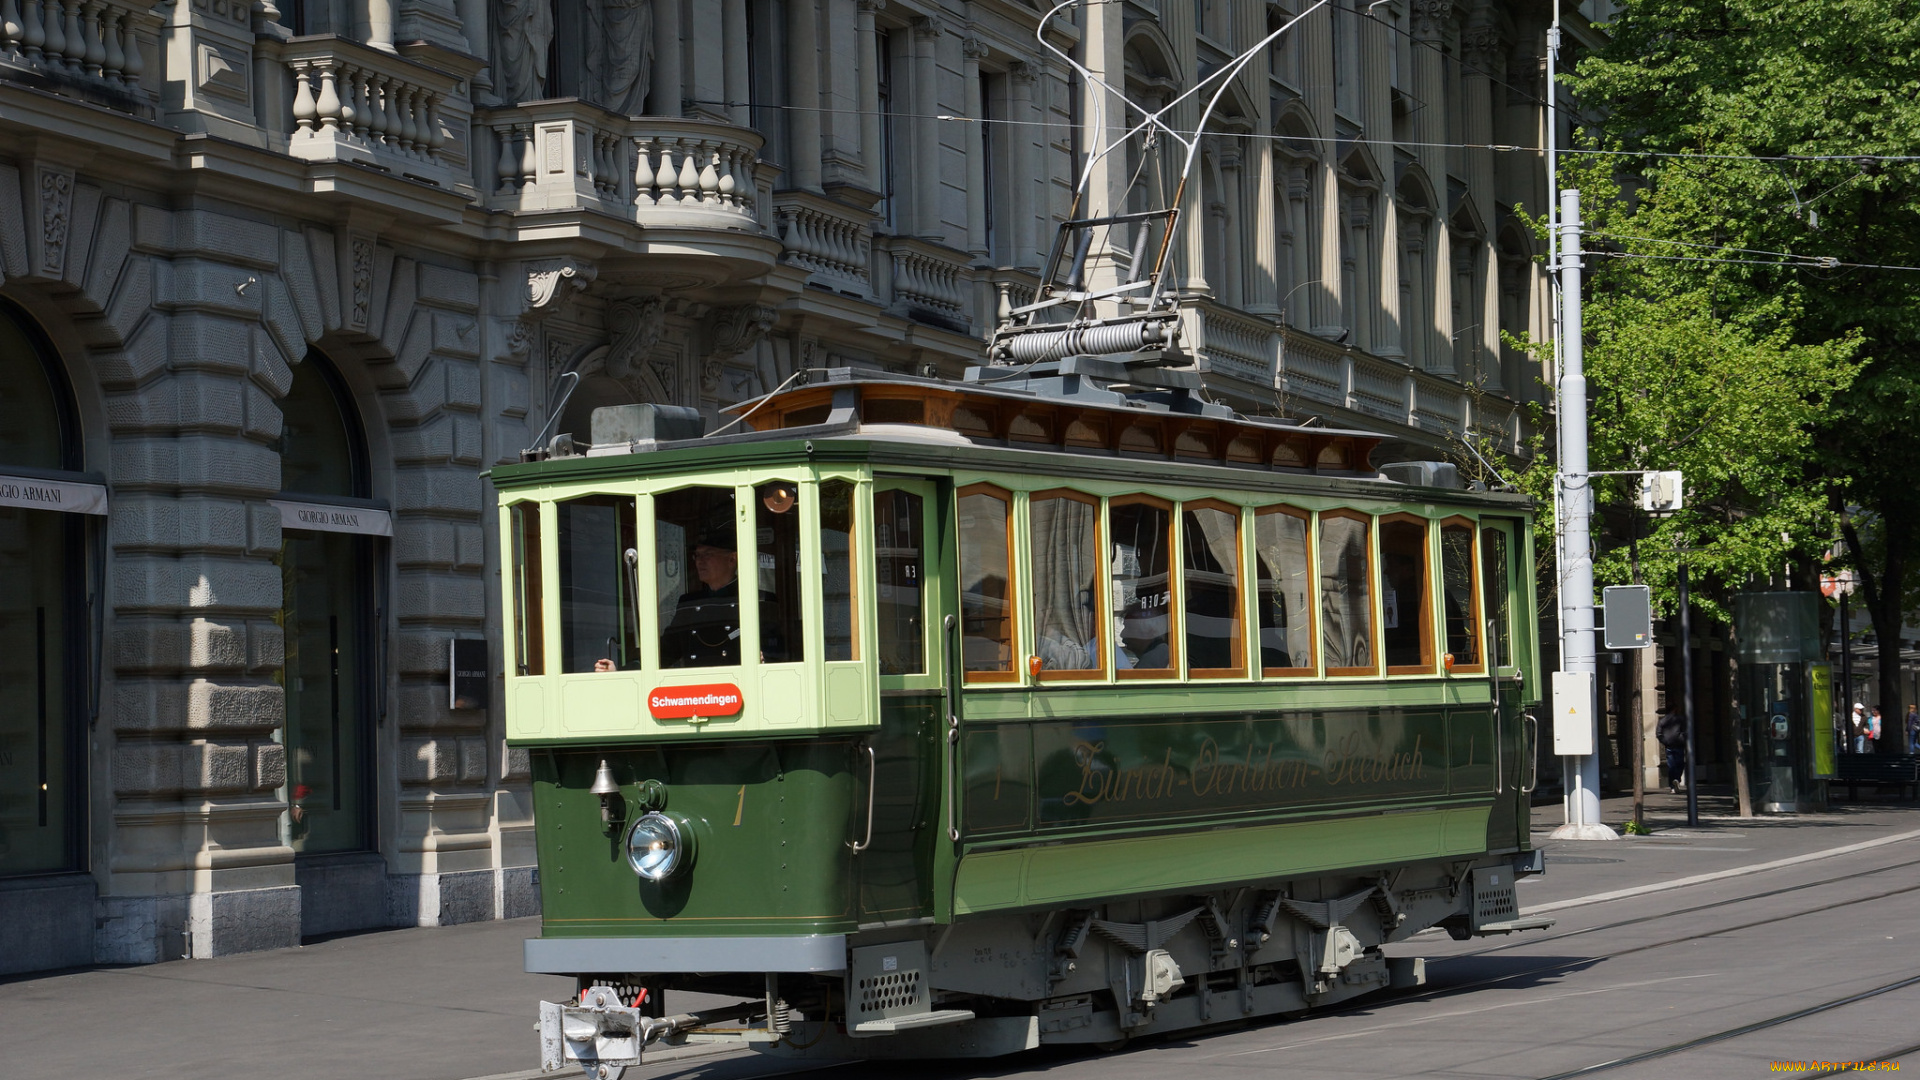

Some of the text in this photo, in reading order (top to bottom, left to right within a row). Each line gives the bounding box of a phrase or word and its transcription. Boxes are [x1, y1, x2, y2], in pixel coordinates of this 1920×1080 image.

[22, 487, 62, 504] ARMANI
[298, 510, 359, 527] GIORGIO ARMANI
[652, 694, 738, 708] Schwamendingen
[733, 784, 747, 826] 1
